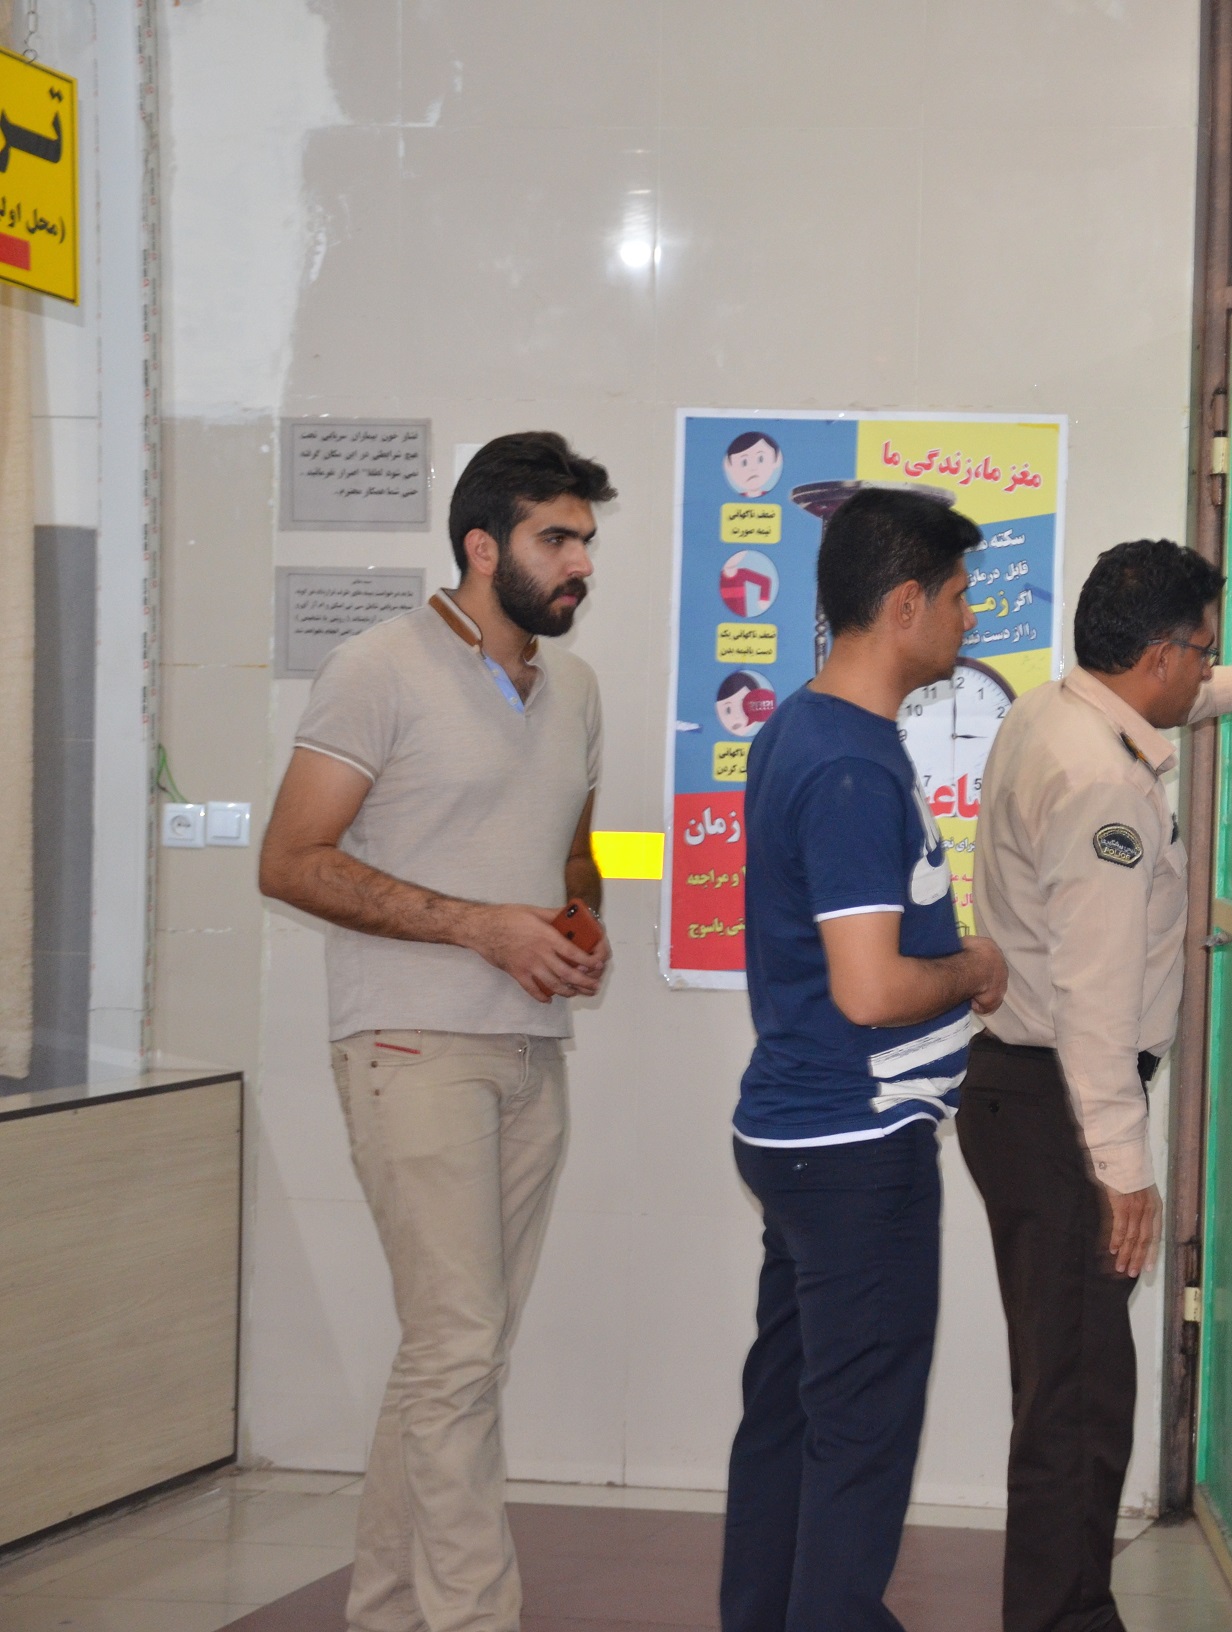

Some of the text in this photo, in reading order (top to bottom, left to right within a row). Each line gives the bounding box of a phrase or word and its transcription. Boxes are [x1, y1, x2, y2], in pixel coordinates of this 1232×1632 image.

[882, 439, 900, 466] ما
[1003, 462, 1042, 493] مغز
[729, 509, 755, 521] ناگهانی
[990, 528, 1026, 549] سکته
[1005, 560, 1029, 582] قابل
[1011, 589, 1033, 613] اگر
[921, 686, 938, 699] 11
[977, 687, 985, 700] 1
[904, 703, 923, 717] 10
[996, 706, 1006, 719] 2
[923, 774, 932, 787] 7
[974, 777, 982, 791] 5
[684, 806, 742, 846] زمان
[685, 868, 730, 889] مراجعه
[731, 872, 740, 888] و
[687, 916, 724, 940] یاسوج
